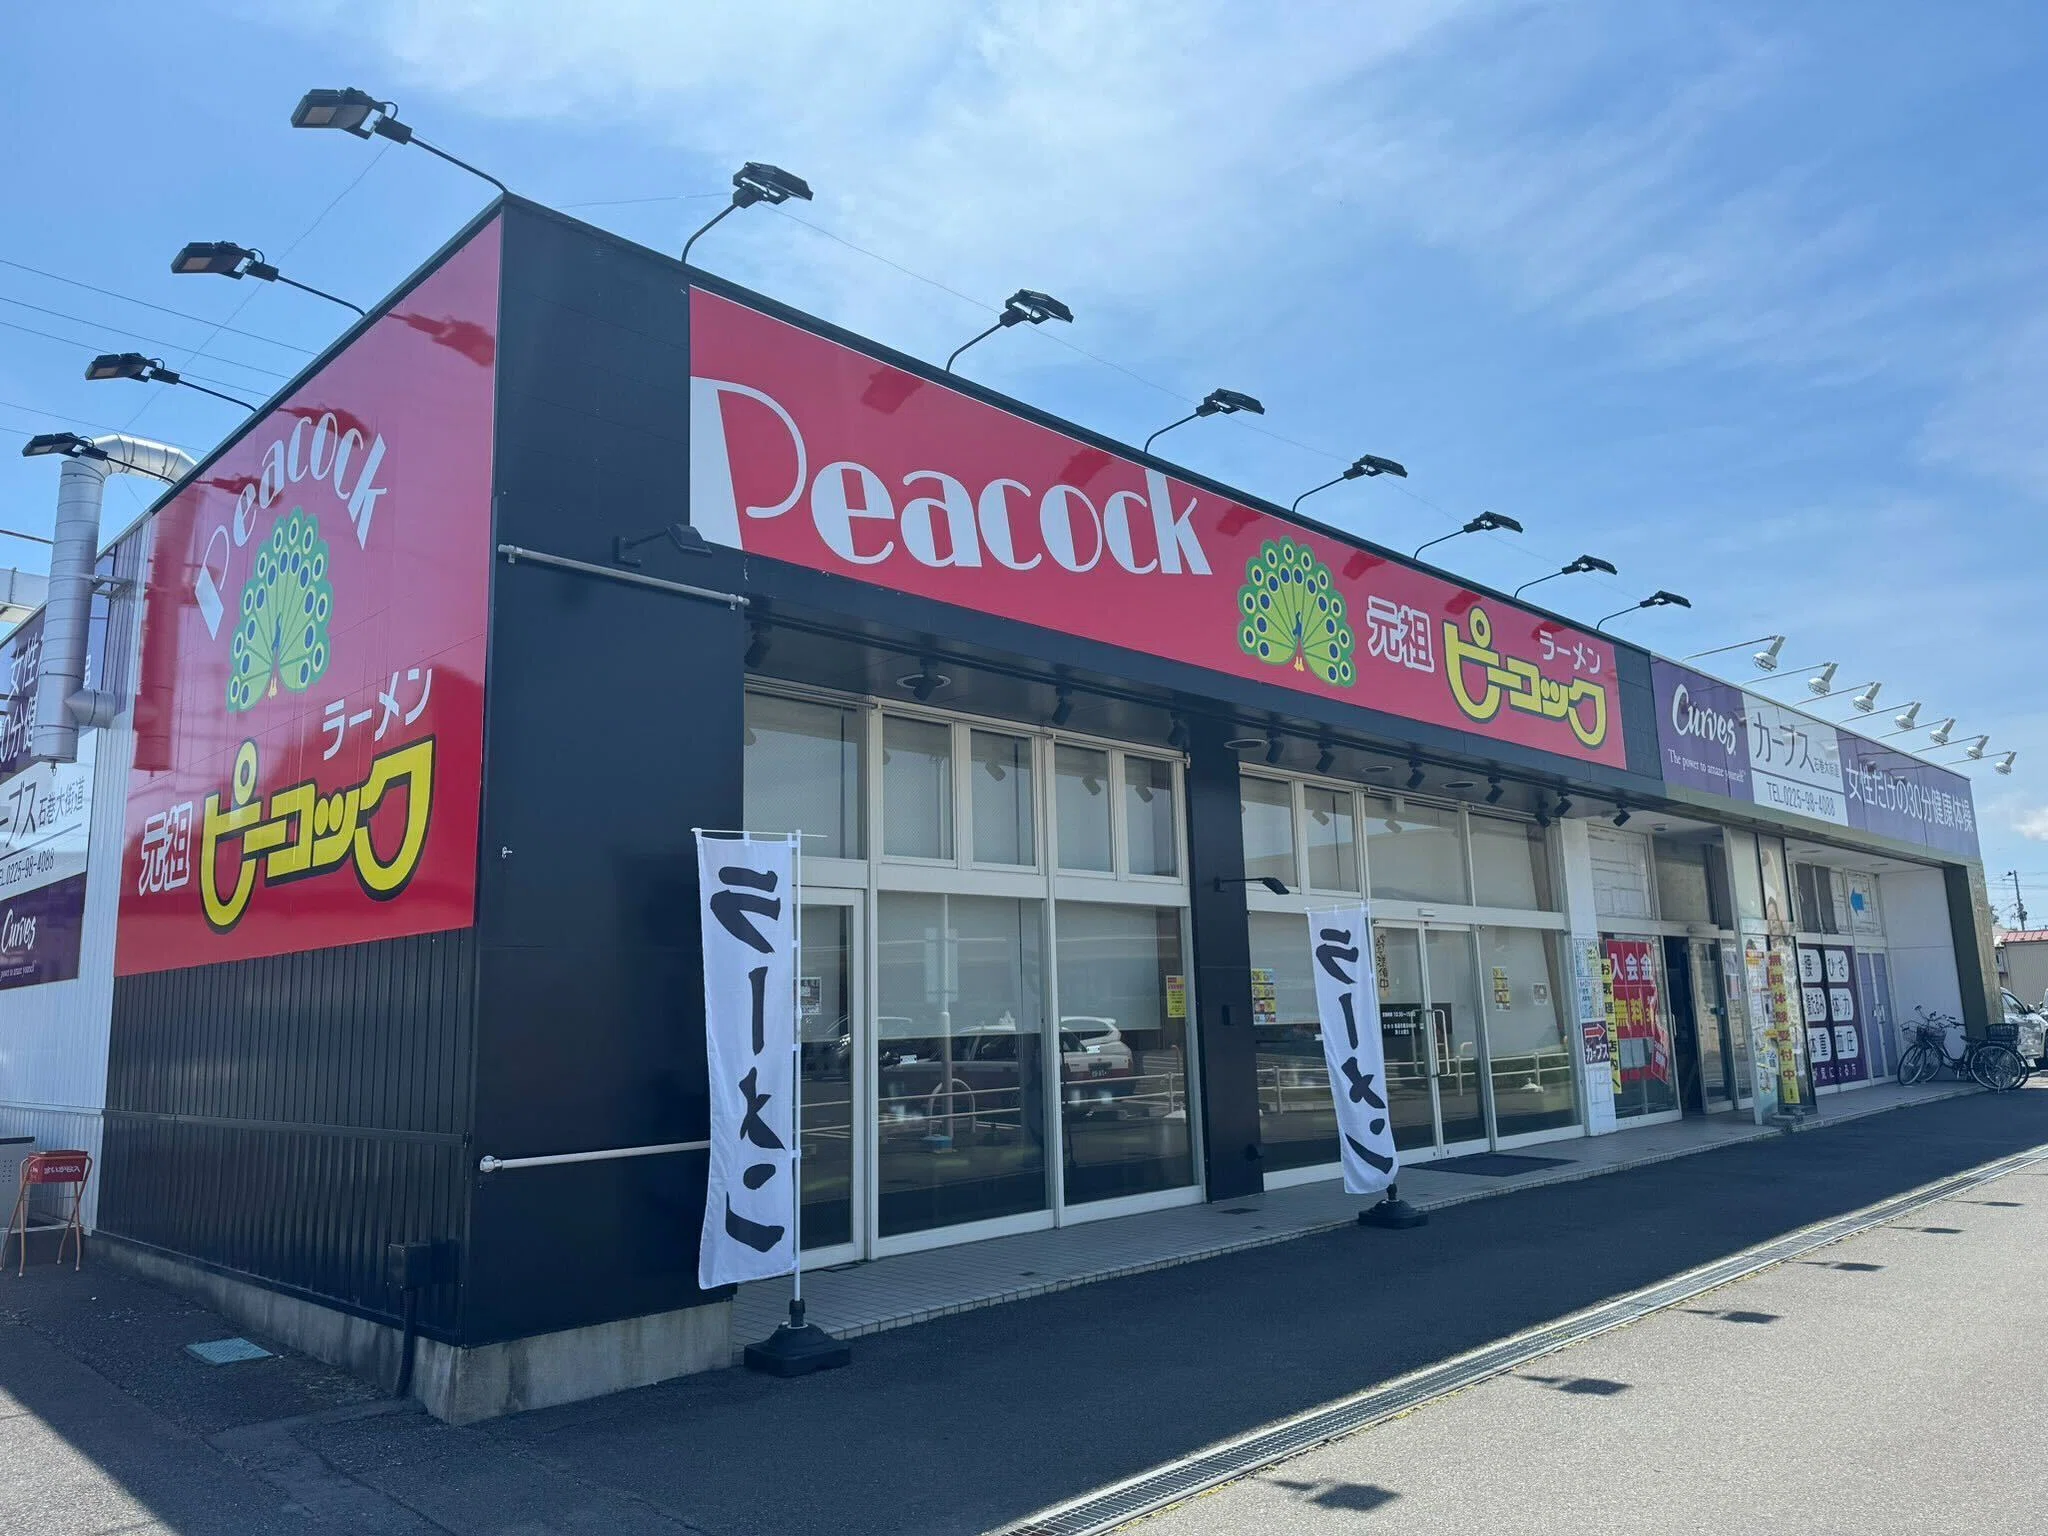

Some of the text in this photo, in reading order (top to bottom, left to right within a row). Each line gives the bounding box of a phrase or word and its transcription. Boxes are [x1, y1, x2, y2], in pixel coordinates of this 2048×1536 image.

[690, 376, 1213, 576] Peacock
[195, 412, 387, 641] Peacock
[8, 632, 44, 702] 女性
[1366, 595, 1608, 750] 元祖 ピーコック
[1539, 630, 1602, 674] ラーメン
[322, 668, 433, 761] ラーメン
[1672, 683, 1736, 755] Curves
[138, 736, 436, 935] 元祖 ピーコック
[1, 908, 36, 953] Curves
[1611, 952, 1654, 982] 入会金
